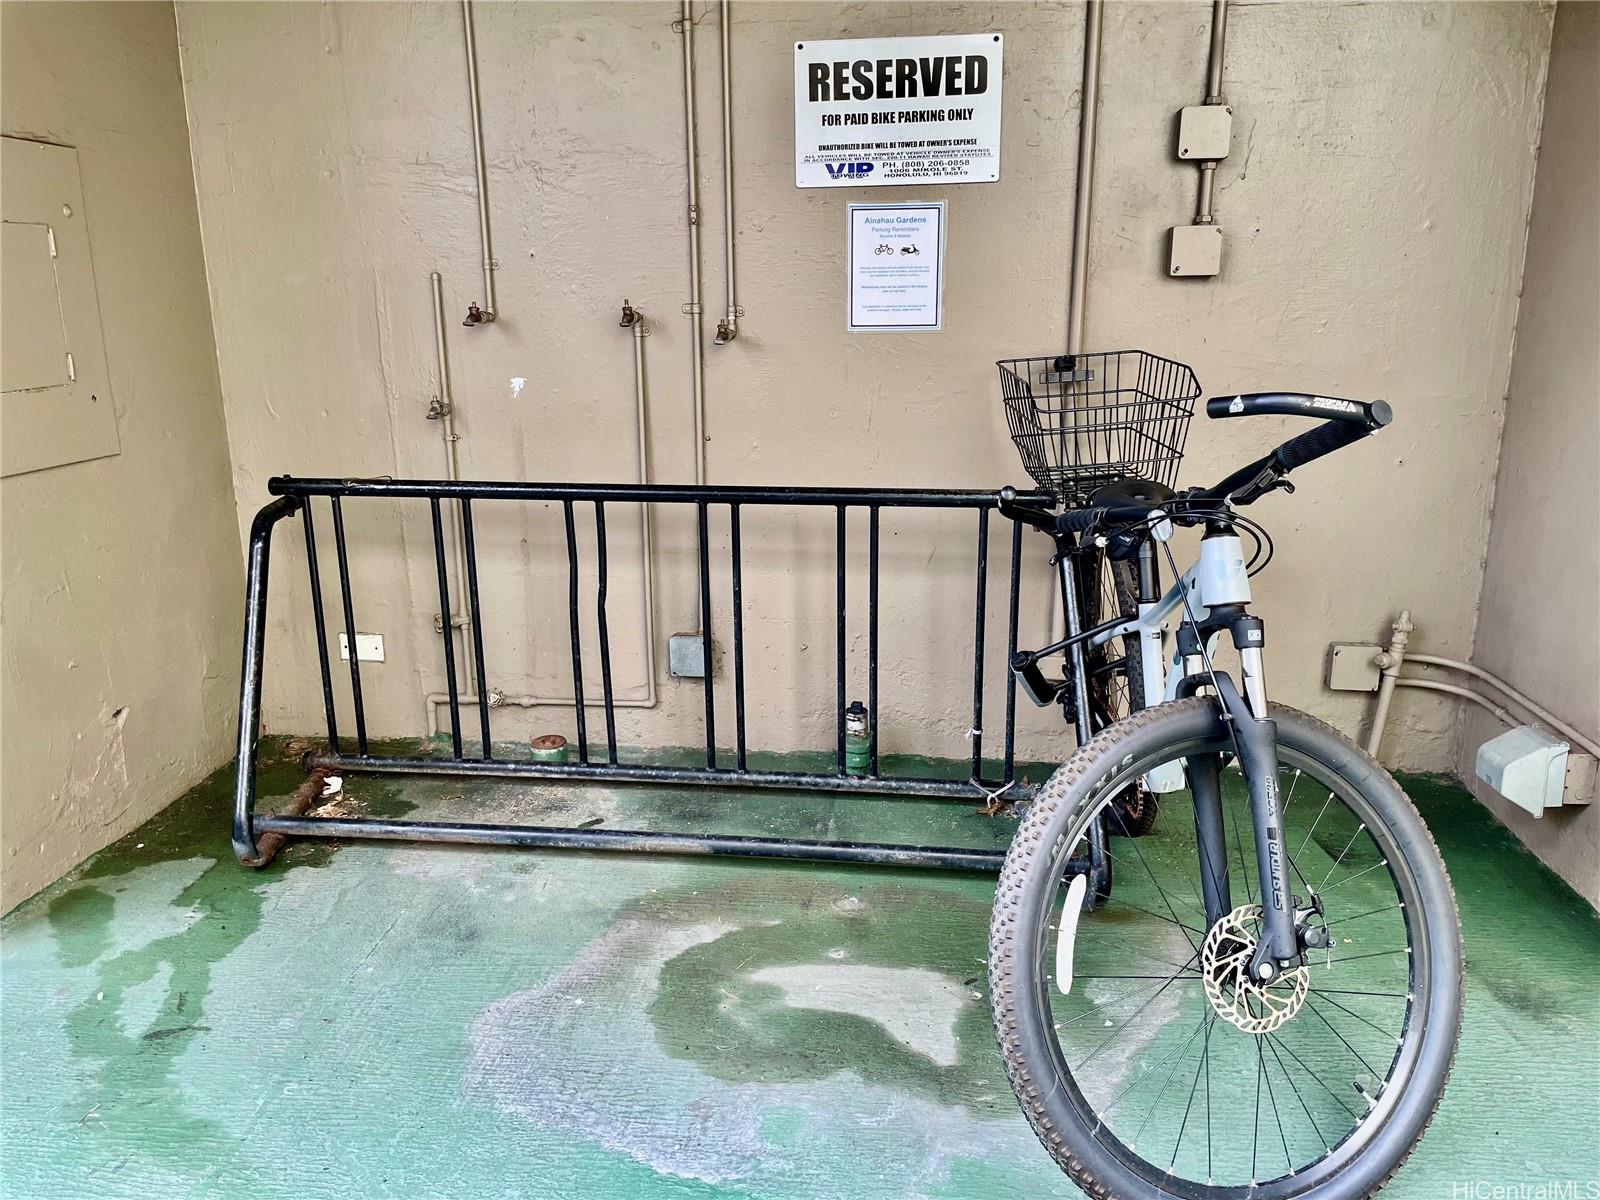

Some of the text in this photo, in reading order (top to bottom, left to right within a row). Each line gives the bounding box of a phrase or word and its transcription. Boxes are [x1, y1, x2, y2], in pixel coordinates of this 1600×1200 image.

[808, 55, 988, 102] RESERVED
[821, 108, 974, 126] FOR PAID BIKE PARKING ONLY
[818, 143, 860, 151] UNAUTHORIZED
[861, 142, 874, 150] BIKE
[889, 141, 897, 149] BE
[898, 140, 918, 148] TOWED
[926, 139, 952, 147] OWNER'S
[953, 138, 978, 146] EXPENSE
[825, 162, 874, 175] VIP
[901, 160, 925, 168] (808)
[927, 159, 970, 167] 206-0858
[896, 216, 927, 224] Gardens
